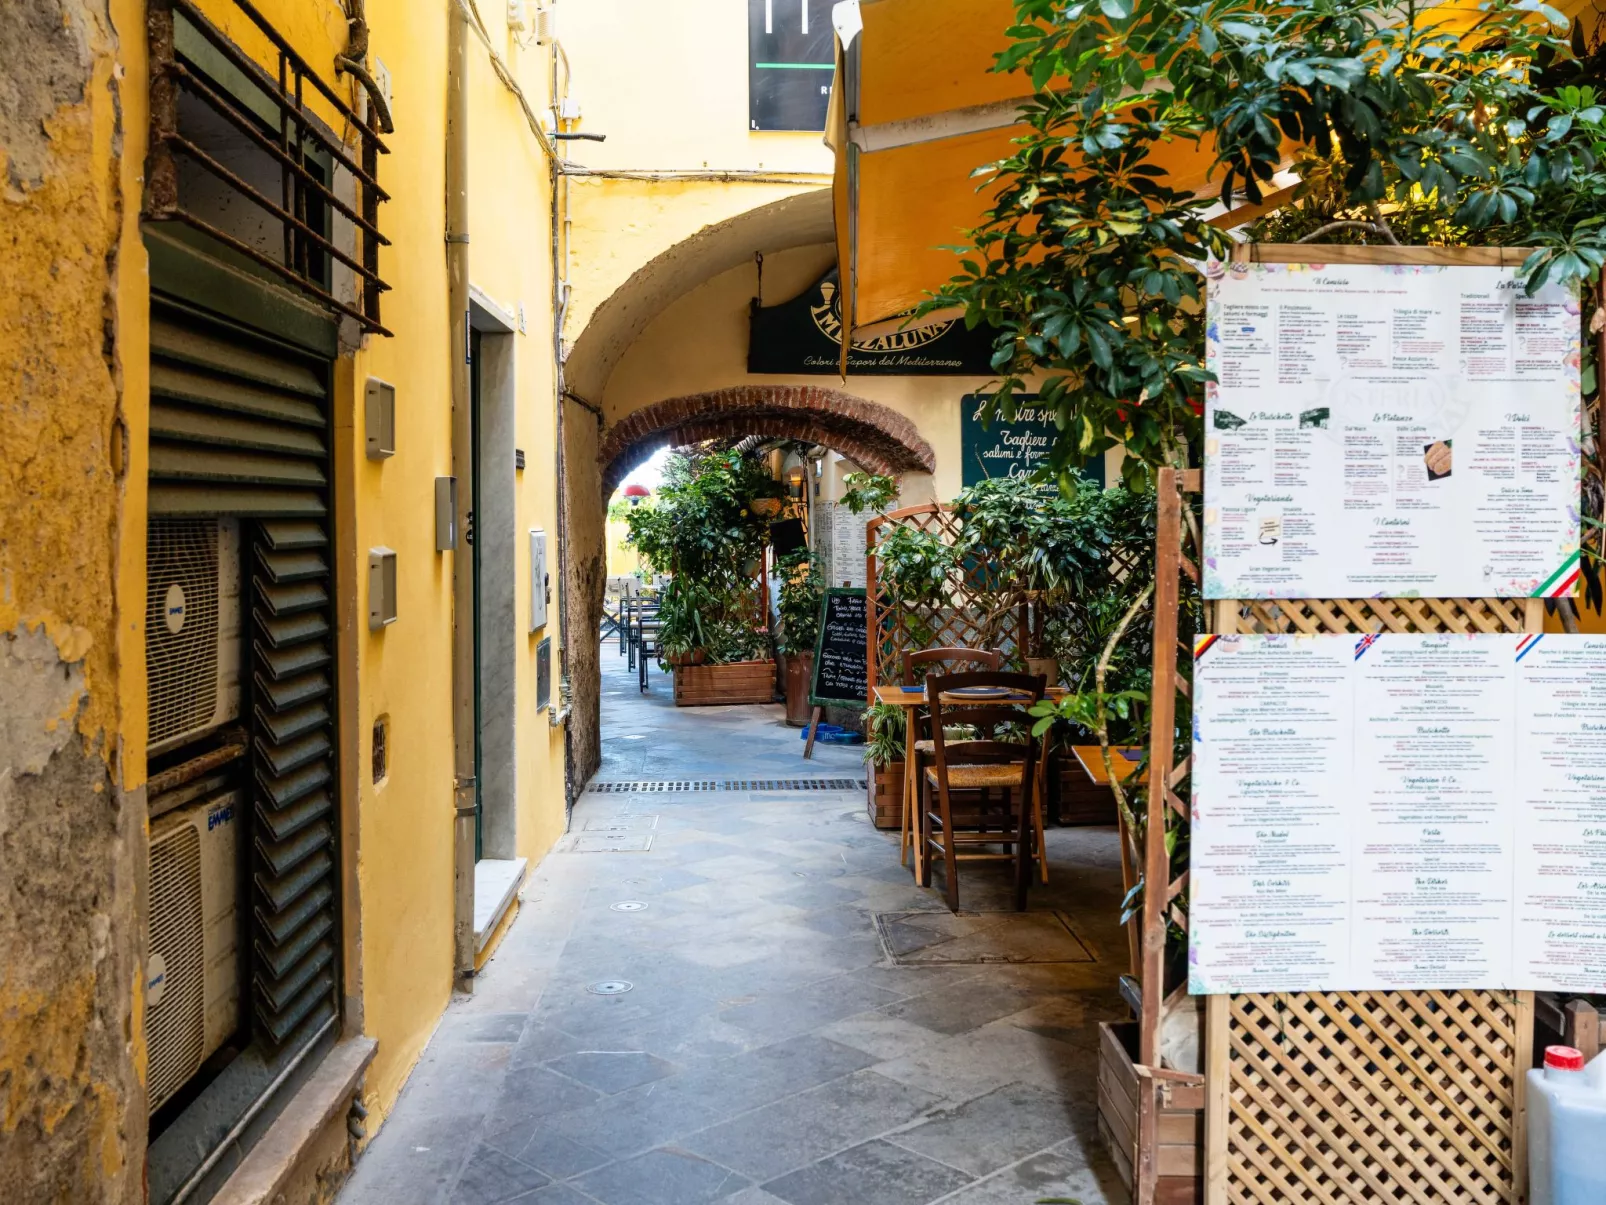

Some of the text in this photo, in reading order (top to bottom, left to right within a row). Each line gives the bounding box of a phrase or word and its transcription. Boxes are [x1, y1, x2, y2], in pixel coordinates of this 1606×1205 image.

[817, 312, 949, 350] MZALUNA
[803, 355, 834, 366] Colori
[878, 355, 894, 366] del
[895, 355, 963, 367] Mediterraneo
[1000, 430, 1047, 452] Tagliere
[982, 445, 1014, 458] salumi
[1016, 450, 1022, 459] e
